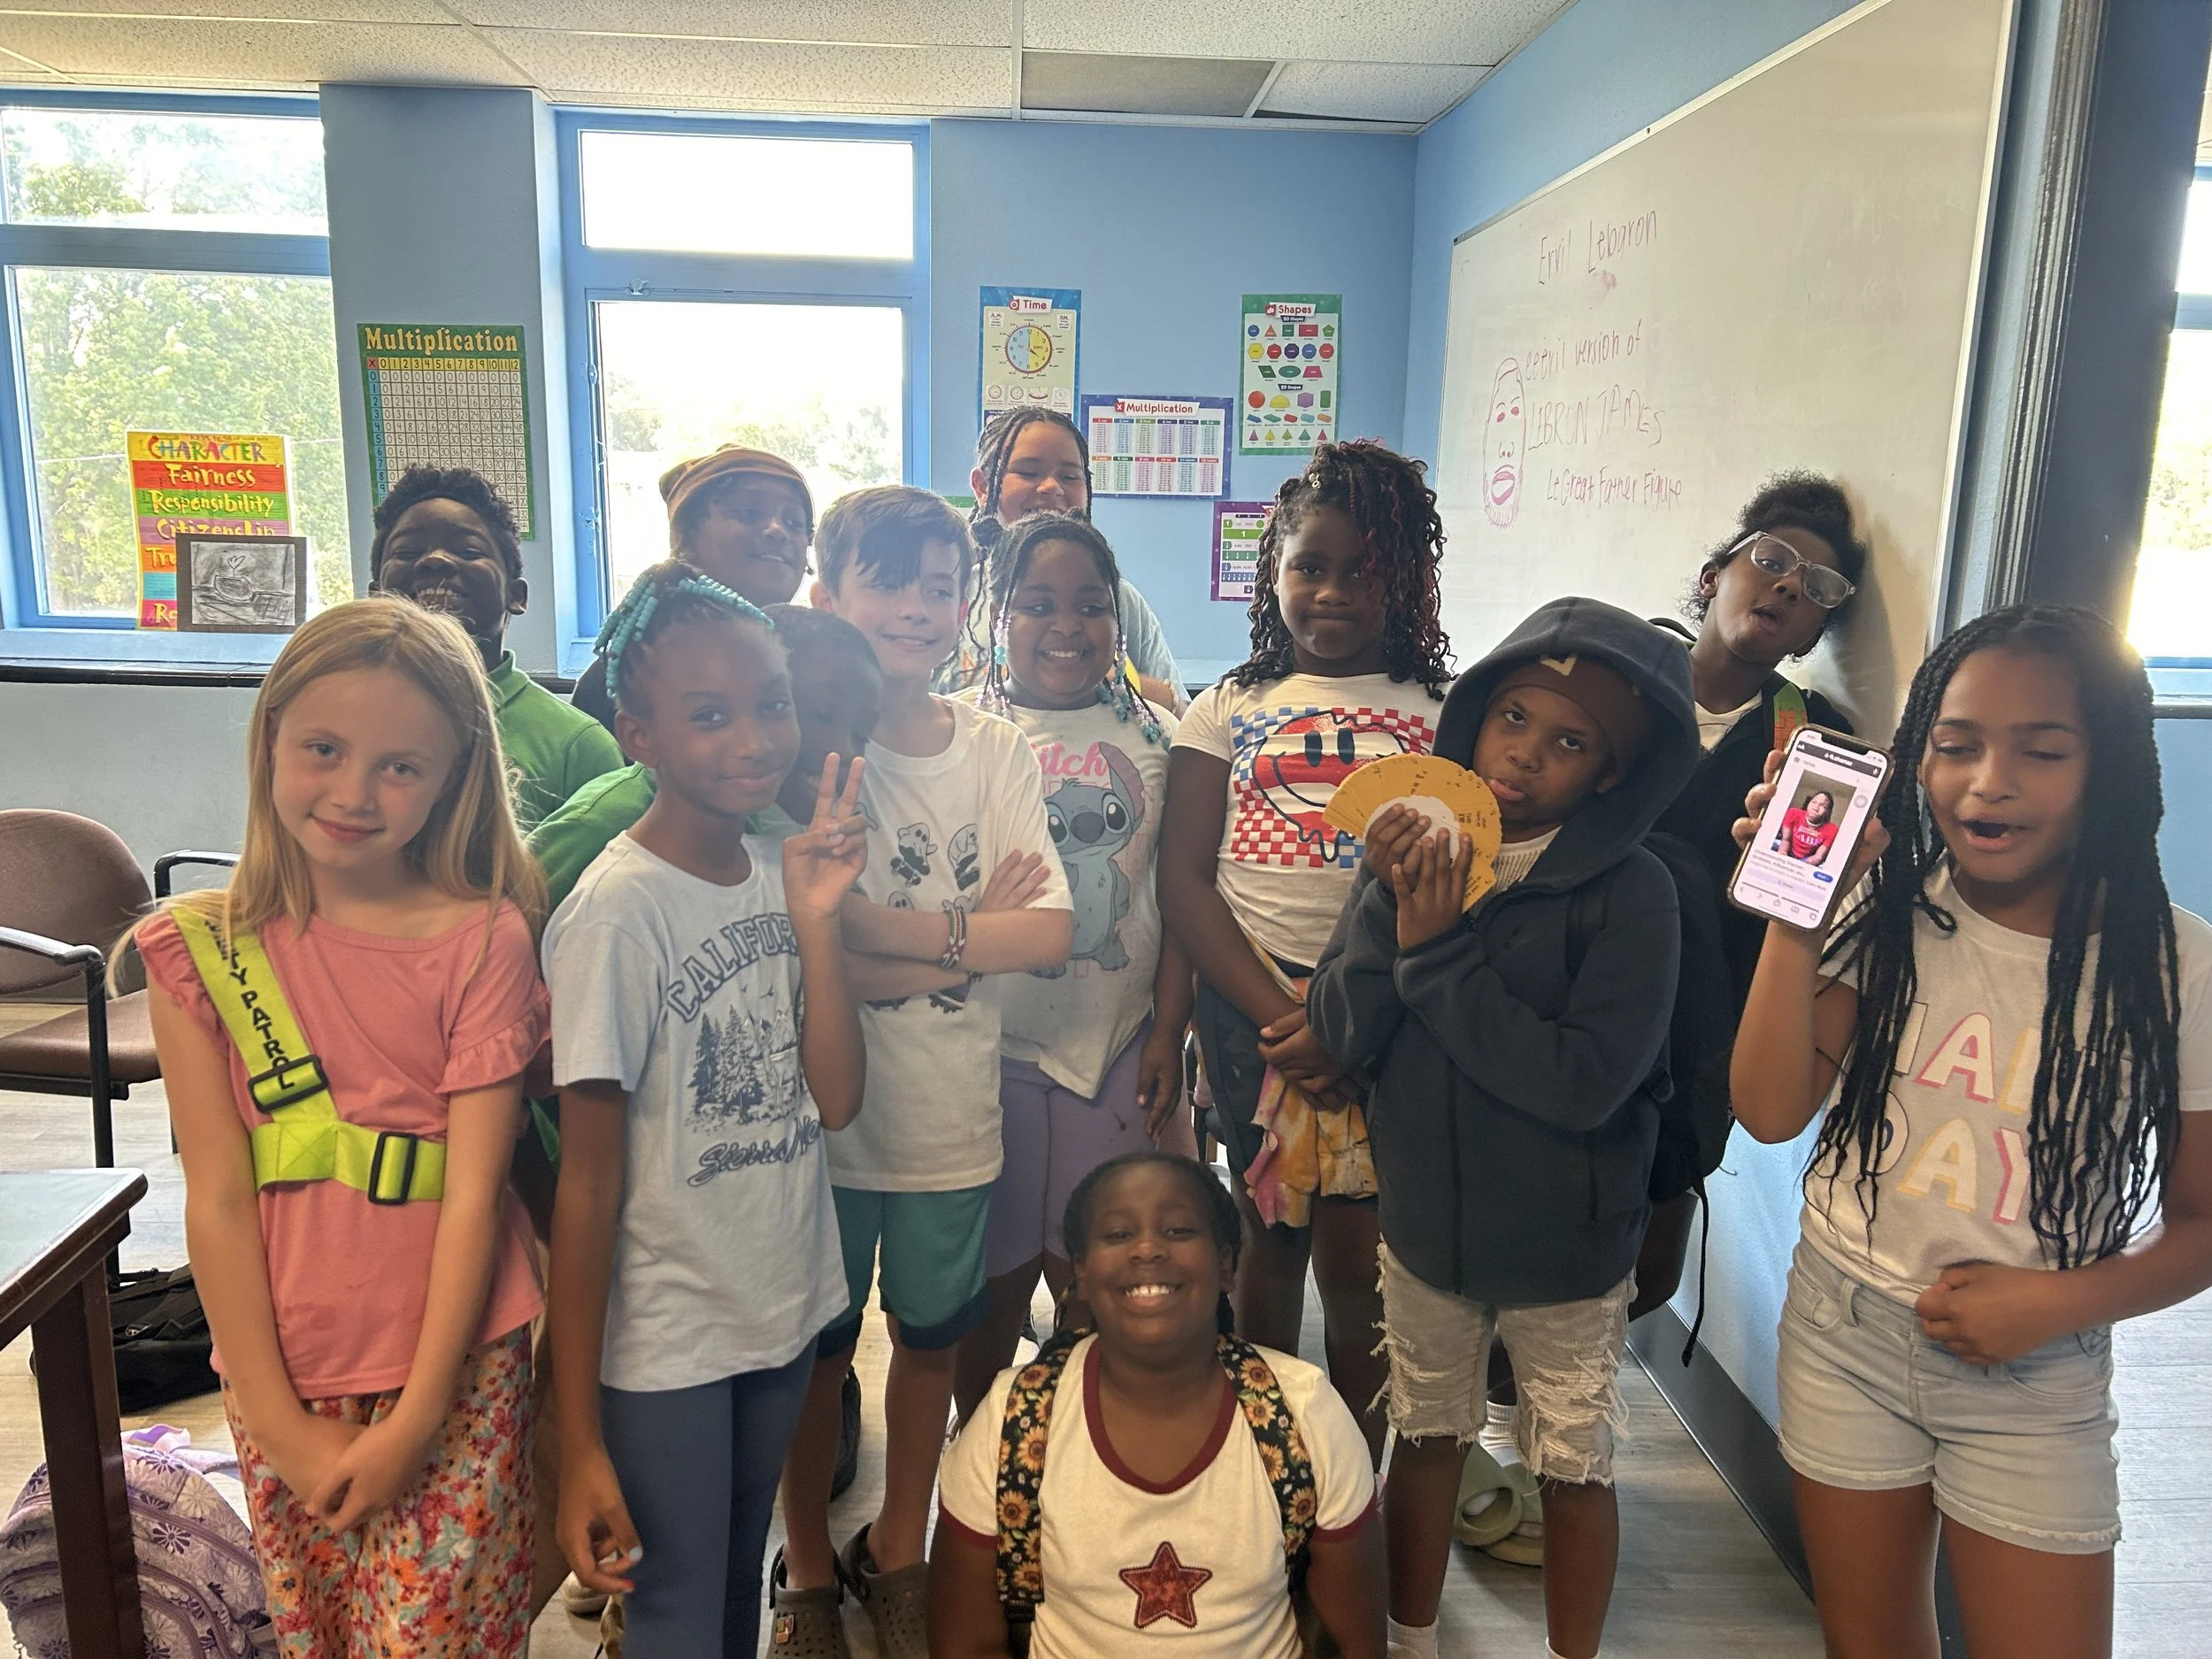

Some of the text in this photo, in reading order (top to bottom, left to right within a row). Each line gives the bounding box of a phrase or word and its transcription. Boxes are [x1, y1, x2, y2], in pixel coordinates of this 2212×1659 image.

[1588, 210, 1657, 273] Lebaron
[1023, 300, 1047, 310] Time
[1278, 305, 1312, 316] Shapes
[365, 326, 518, 356] Multiplication
[1575, 329, 1619, 366] version
[1627, 318, 1642, 356] of
[380, 359, 386, 368] 0
[403, 359, 408, 368] 2
[414, 359, 419, 368] 3
[424, 359, 430, 368] 4
[435, 359, 441, 368] 5
[446, 360, 451, 368] 6
[458, 359, 462, 368] 7
[468, 360, 473, 369] 8
[479, 359, 484, 368] 9
[489, 360, 497, 369] 10
[510, 360, 518, 369] 12
[370, 371, 518, 381] 0 0 0 0 0 0 0 0 0 0 0 0 0 0
[382, 384, 388, 393] 0
[405, 384, 410, 393] 2
[415, 384, 421, 393] 3
[437, 385, 442, 394] 5
[448, 385, 453, 394] 6
[460, 385, 464, 393] 7
[470, 385, 475, 394] 8
[481, 385, 486, 394] 9
[489, 385, 498, 394] 10
[511, 385, 520, 394] 12
[373, 397, 520, 407] 2 0 2 4 6 8 10 12 14 16 18 20 22 24
[374, 409, 522, 419] 3 0 3 6 9 12 15 18 21 24 27 30 33 36
[1126, 403, 1193, 414] Multiplication
[1597, 384, 1665, 448] JAMES
[374, 422, 522, 432] 4 0 4 8 12 16 20 24 28 32 36 40 44 48
[376, 434, 523, 444] 5 0 5 10 15 20 25 30 35 40 45 50 55 60
[147, 435, 267, 462] CHARACTER
[377, 447, 524, 457] 6 0 6 12 18 24 30 36 42 48 54 60 66 72
[165, 462, 257, 488] Fairness
[1598, 465, 1638, 509] Father
[149, 489, 274, 518] Responsibility
